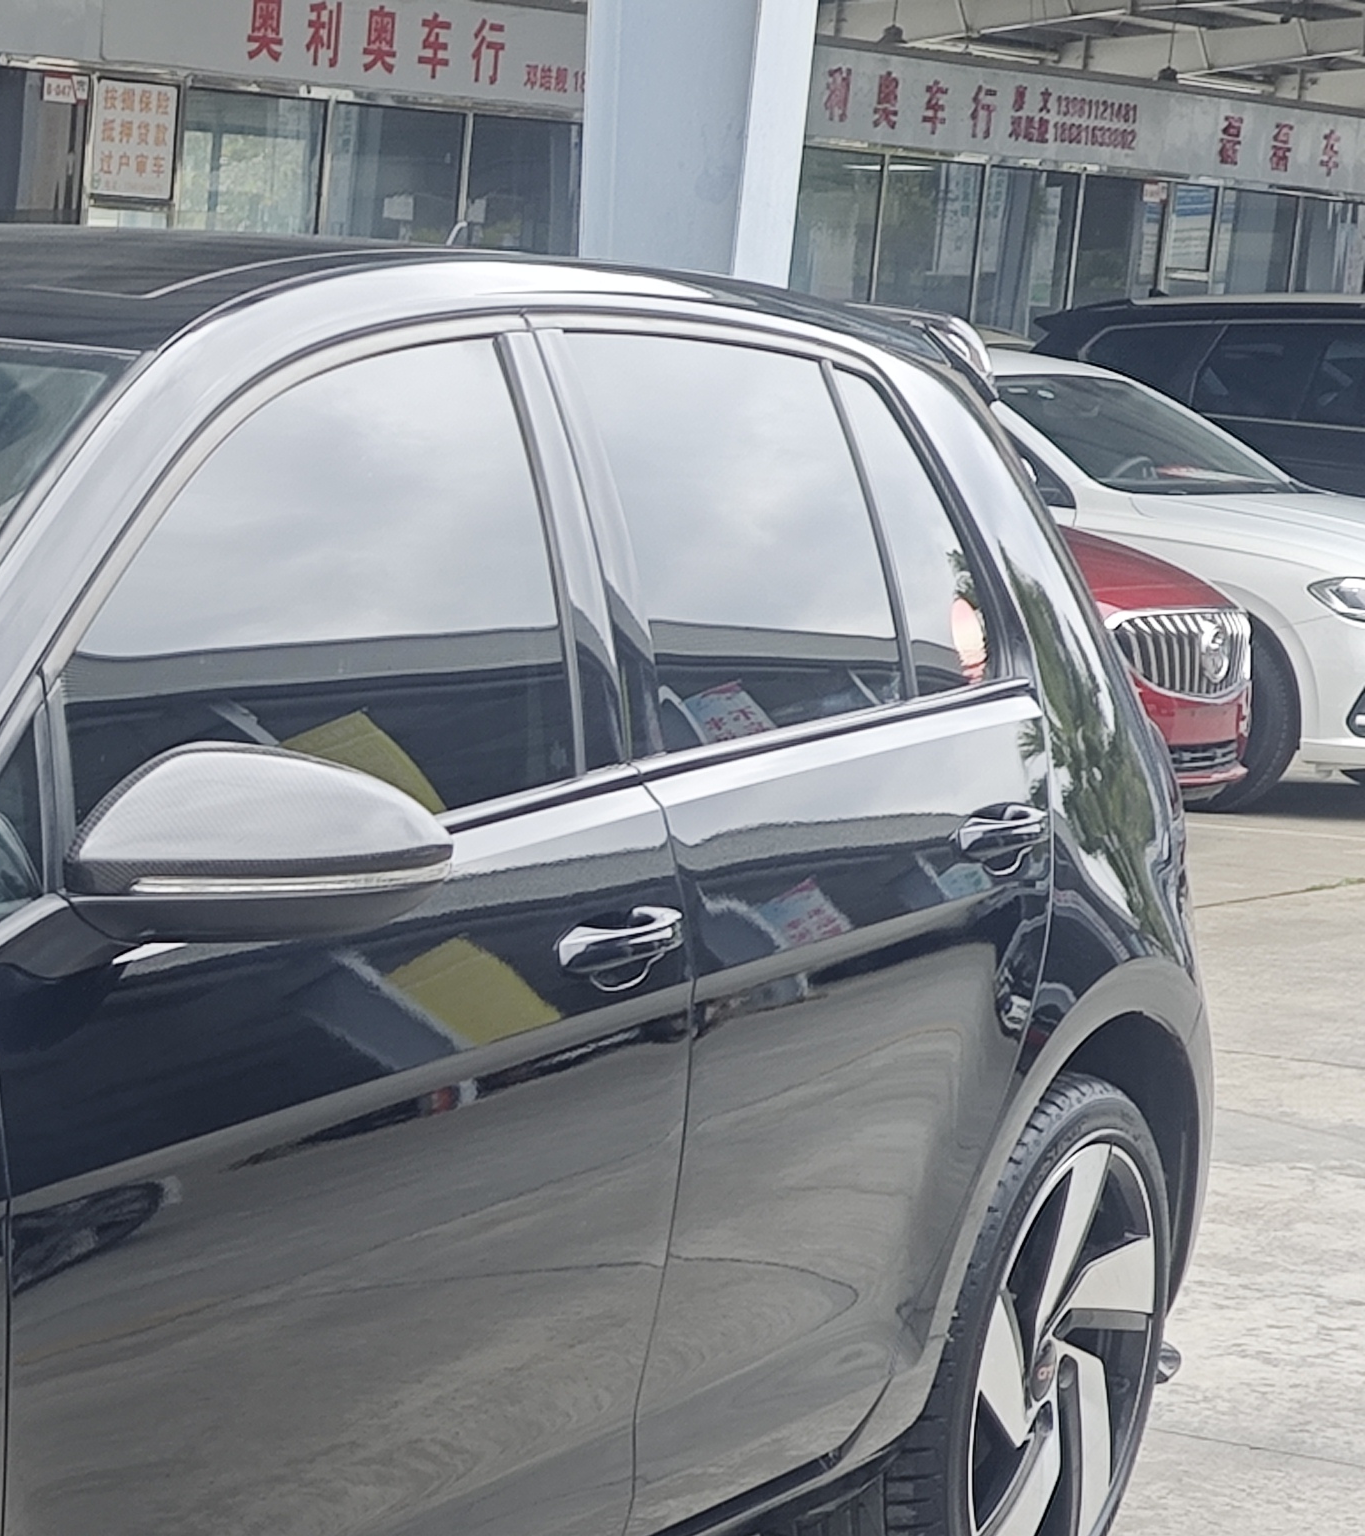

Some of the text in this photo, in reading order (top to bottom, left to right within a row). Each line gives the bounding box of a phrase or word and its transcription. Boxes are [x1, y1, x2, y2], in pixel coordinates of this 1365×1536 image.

[246, 0, 506, 86] 奥利奥车行
